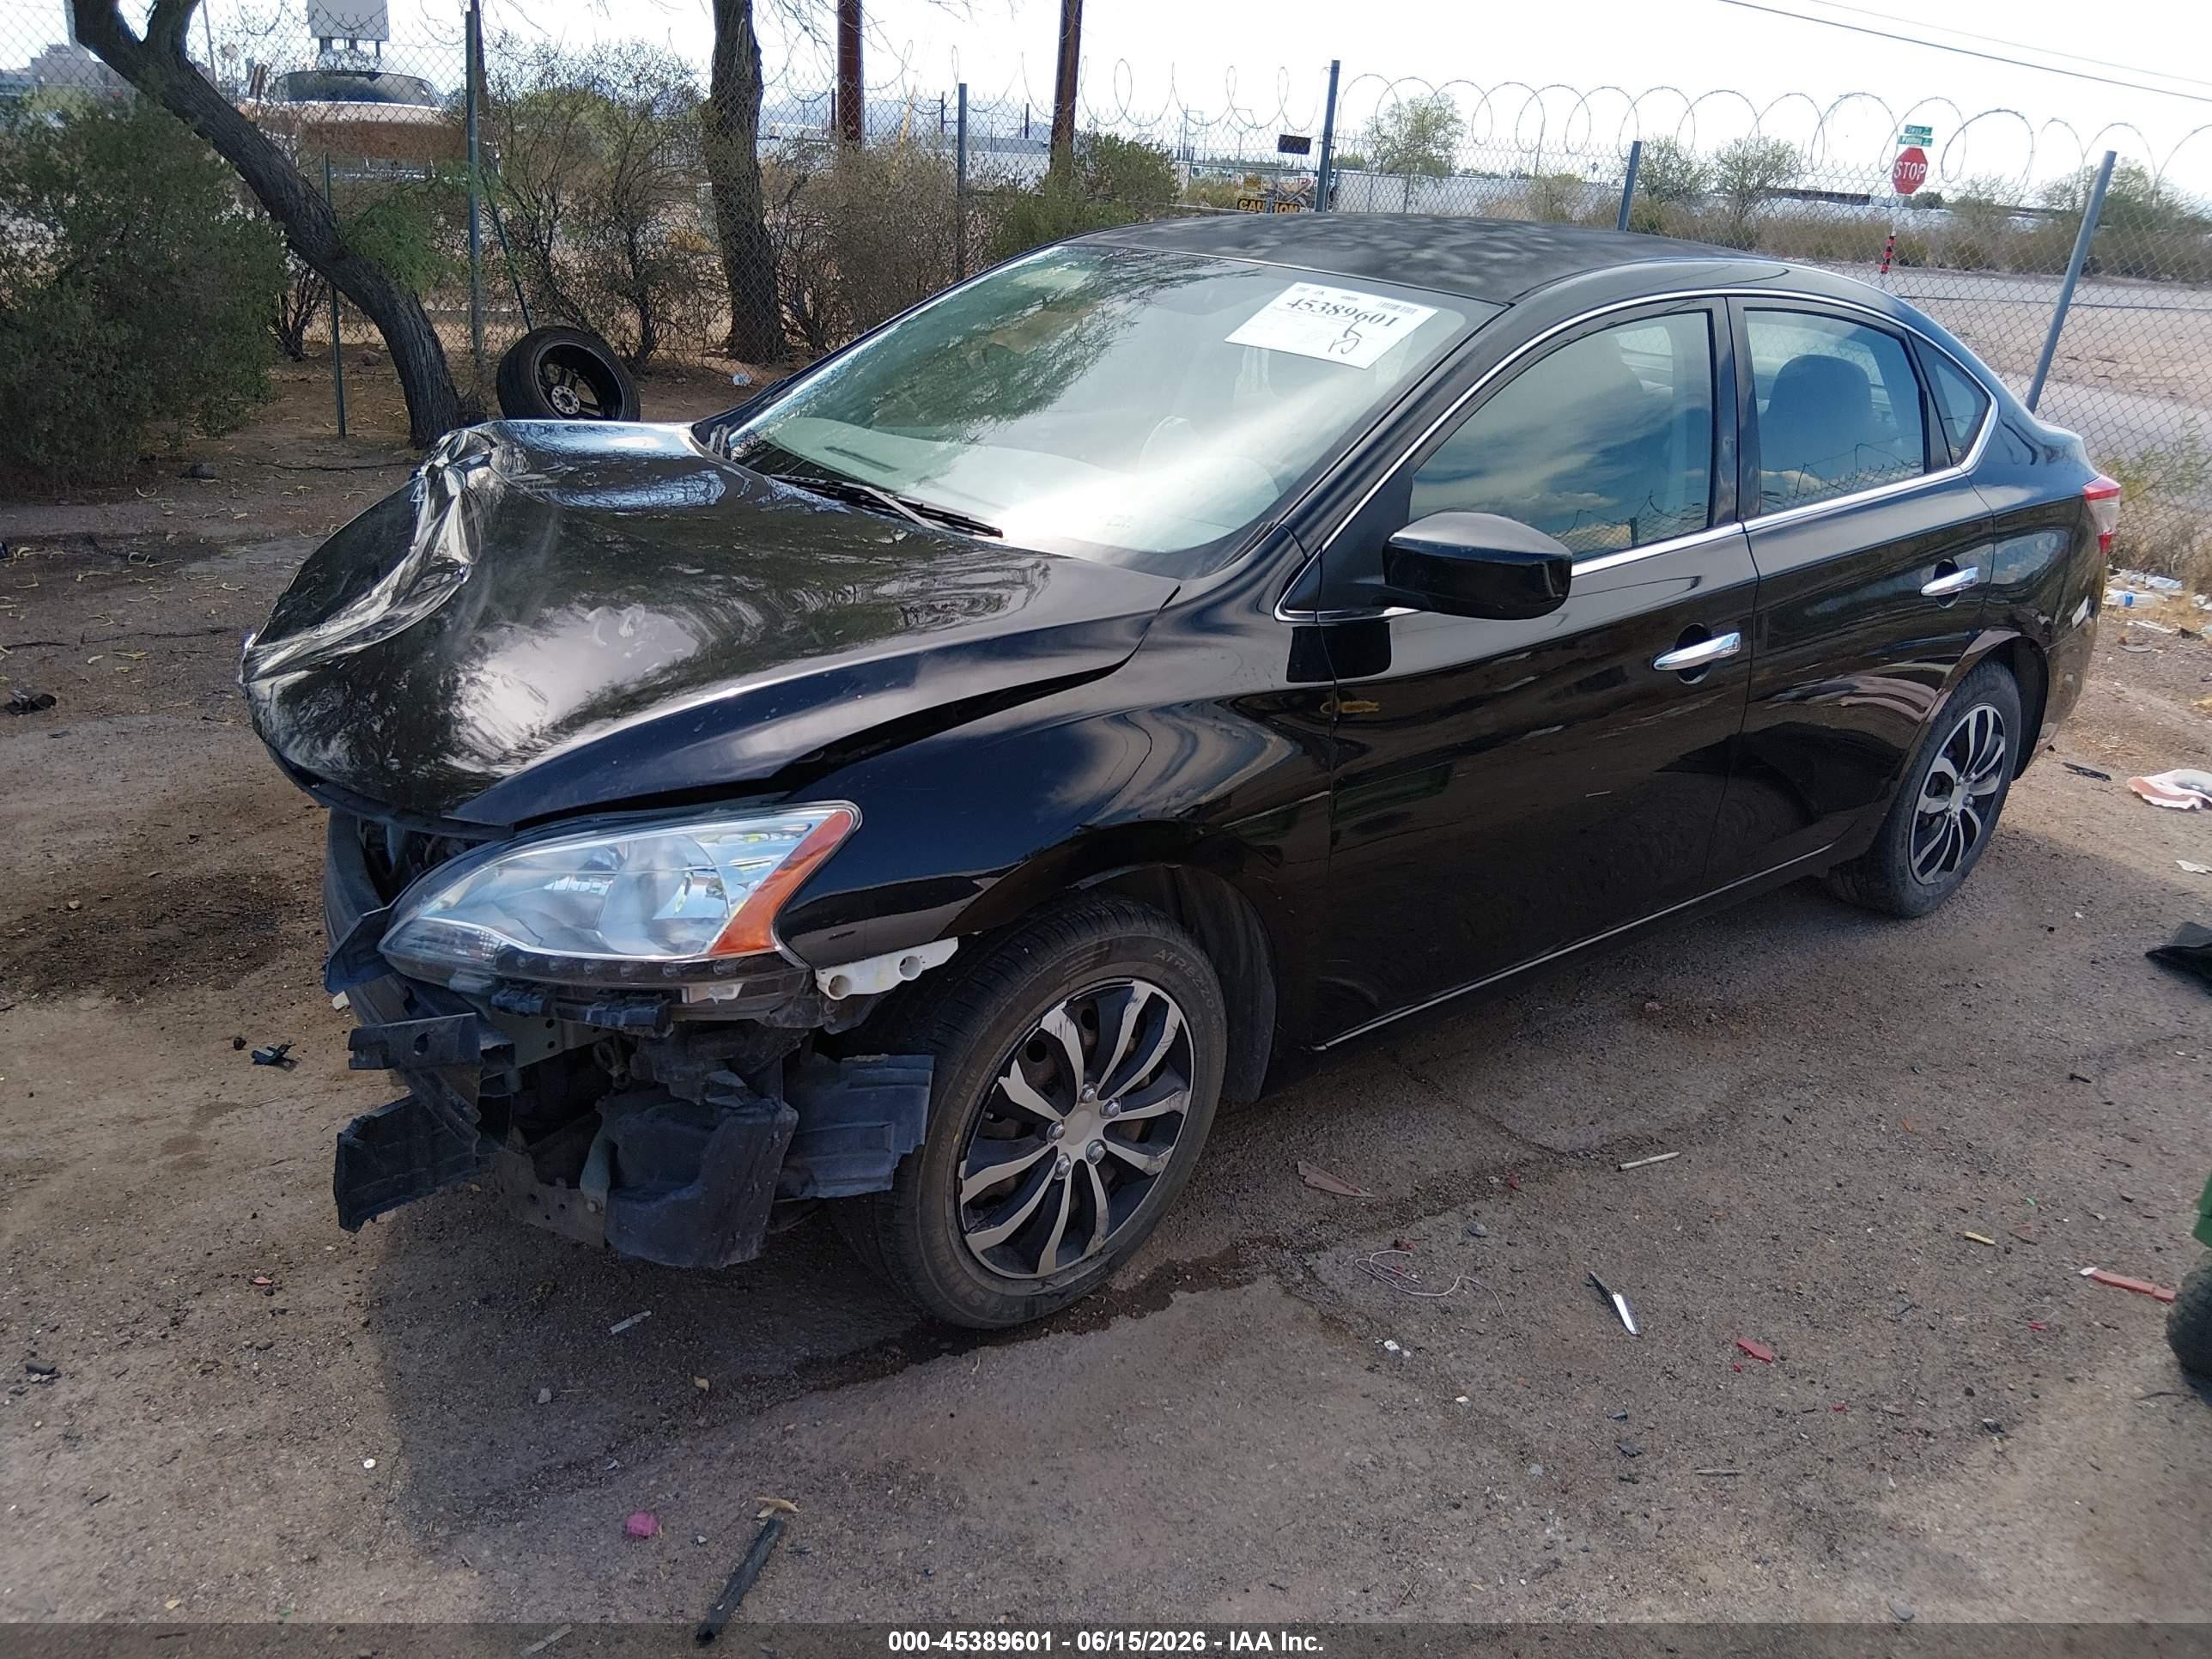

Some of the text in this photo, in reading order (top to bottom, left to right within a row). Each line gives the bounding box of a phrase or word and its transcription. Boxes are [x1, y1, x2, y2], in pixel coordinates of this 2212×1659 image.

[1893, 161, 1926, 180] STOP
[1238, 199, 1298, 214] CAUION
[1286, 297, 1400, 327] 45389601
[1153, 949, 1215, 1009] ATREZZO
